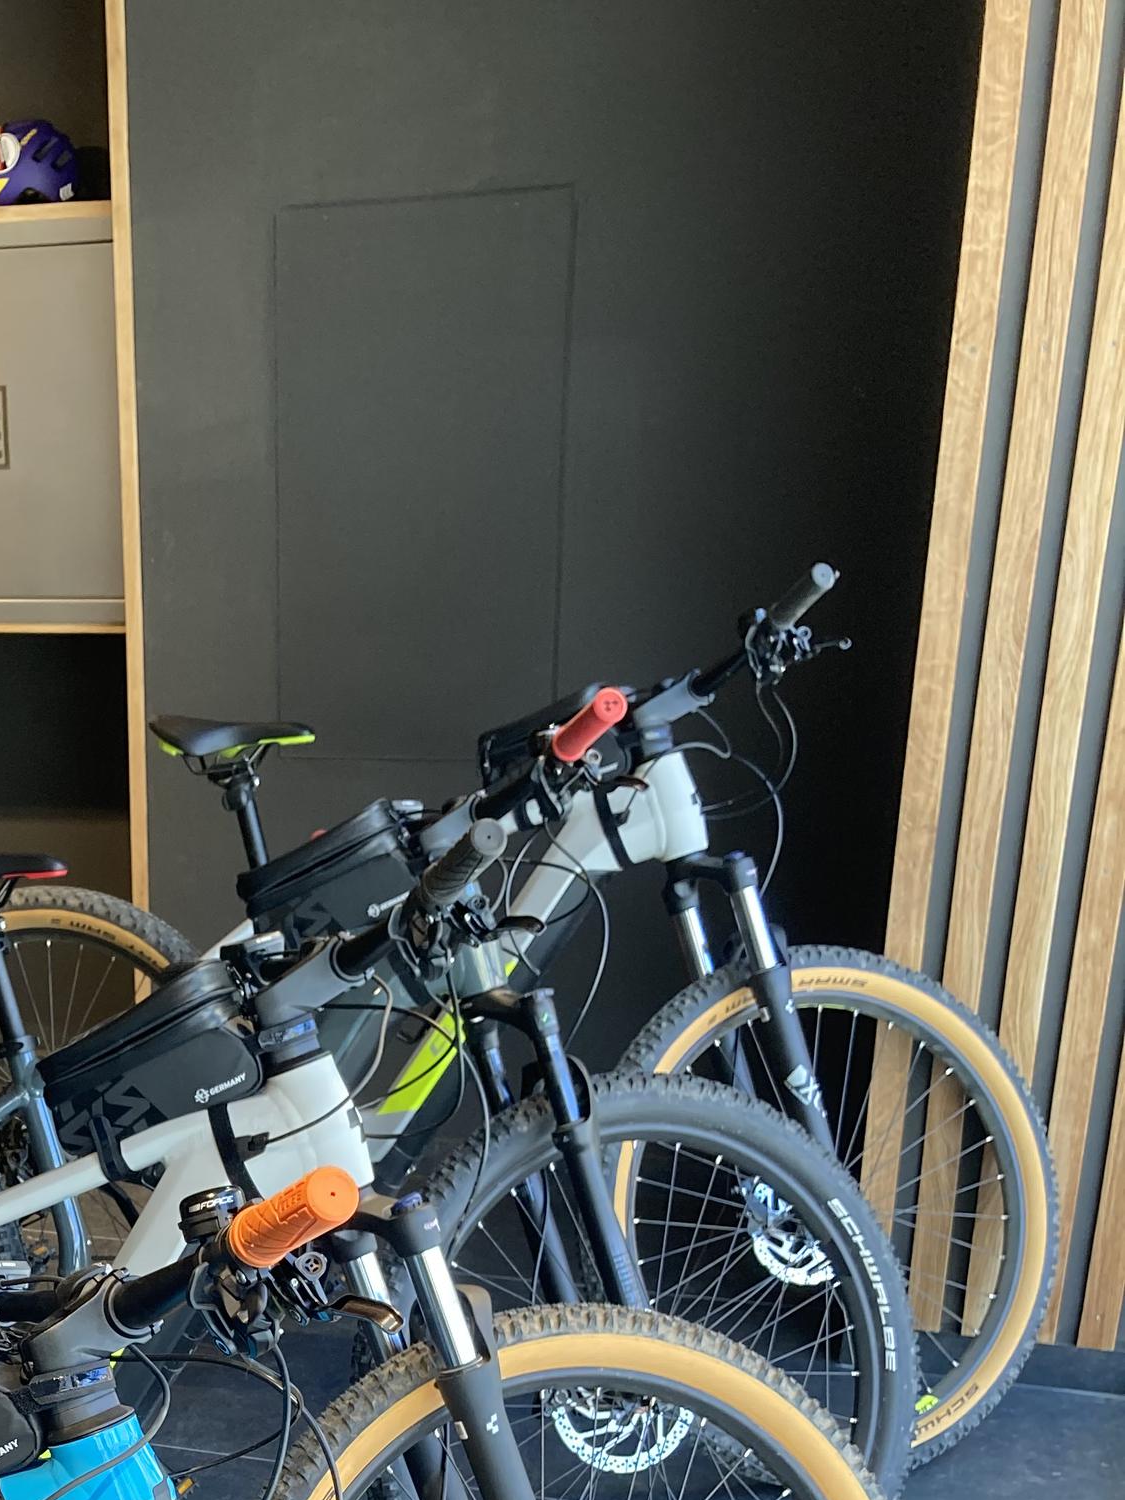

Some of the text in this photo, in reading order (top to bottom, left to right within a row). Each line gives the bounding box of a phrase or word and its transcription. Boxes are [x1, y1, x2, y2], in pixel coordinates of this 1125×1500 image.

[208, 1071, 247, 1096] GERMANY
[199, 1195, 235, 1212] FORCE
[826, 1197, 897, 1373] SCHWALBE
